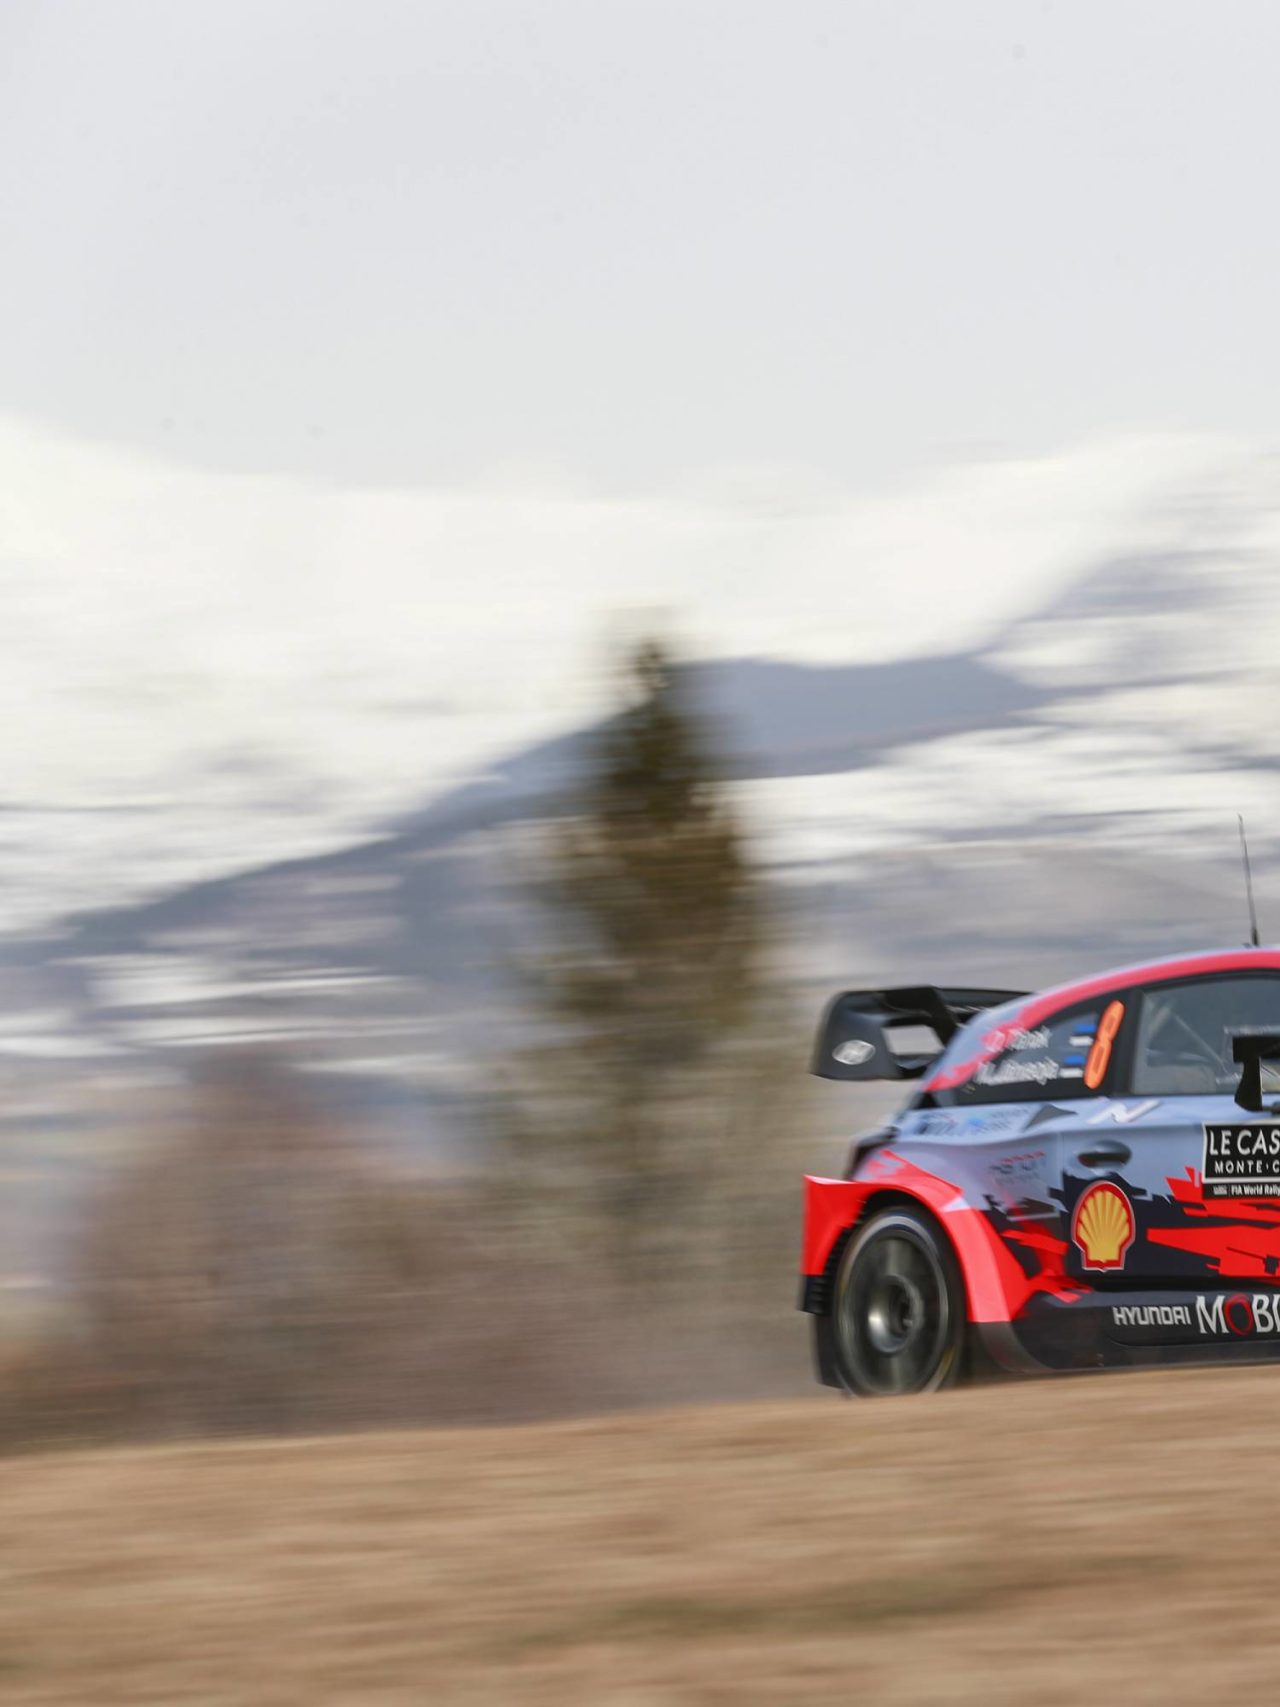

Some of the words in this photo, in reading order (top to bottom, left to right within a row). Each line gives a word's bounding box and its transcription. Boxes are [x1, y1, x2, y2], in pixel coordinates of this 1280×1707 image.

[1084, 1000, 1125, 1089] 8
[1209, 1128, 1232, 1156] LE
[1231, 1184, 1243, 1196] FIA
[1244, 1184, 1263, 1196] World
[1264, 1184, 1280, 1197] Rally
[1112, 1305, 1192, 1326] HYUNDAI
